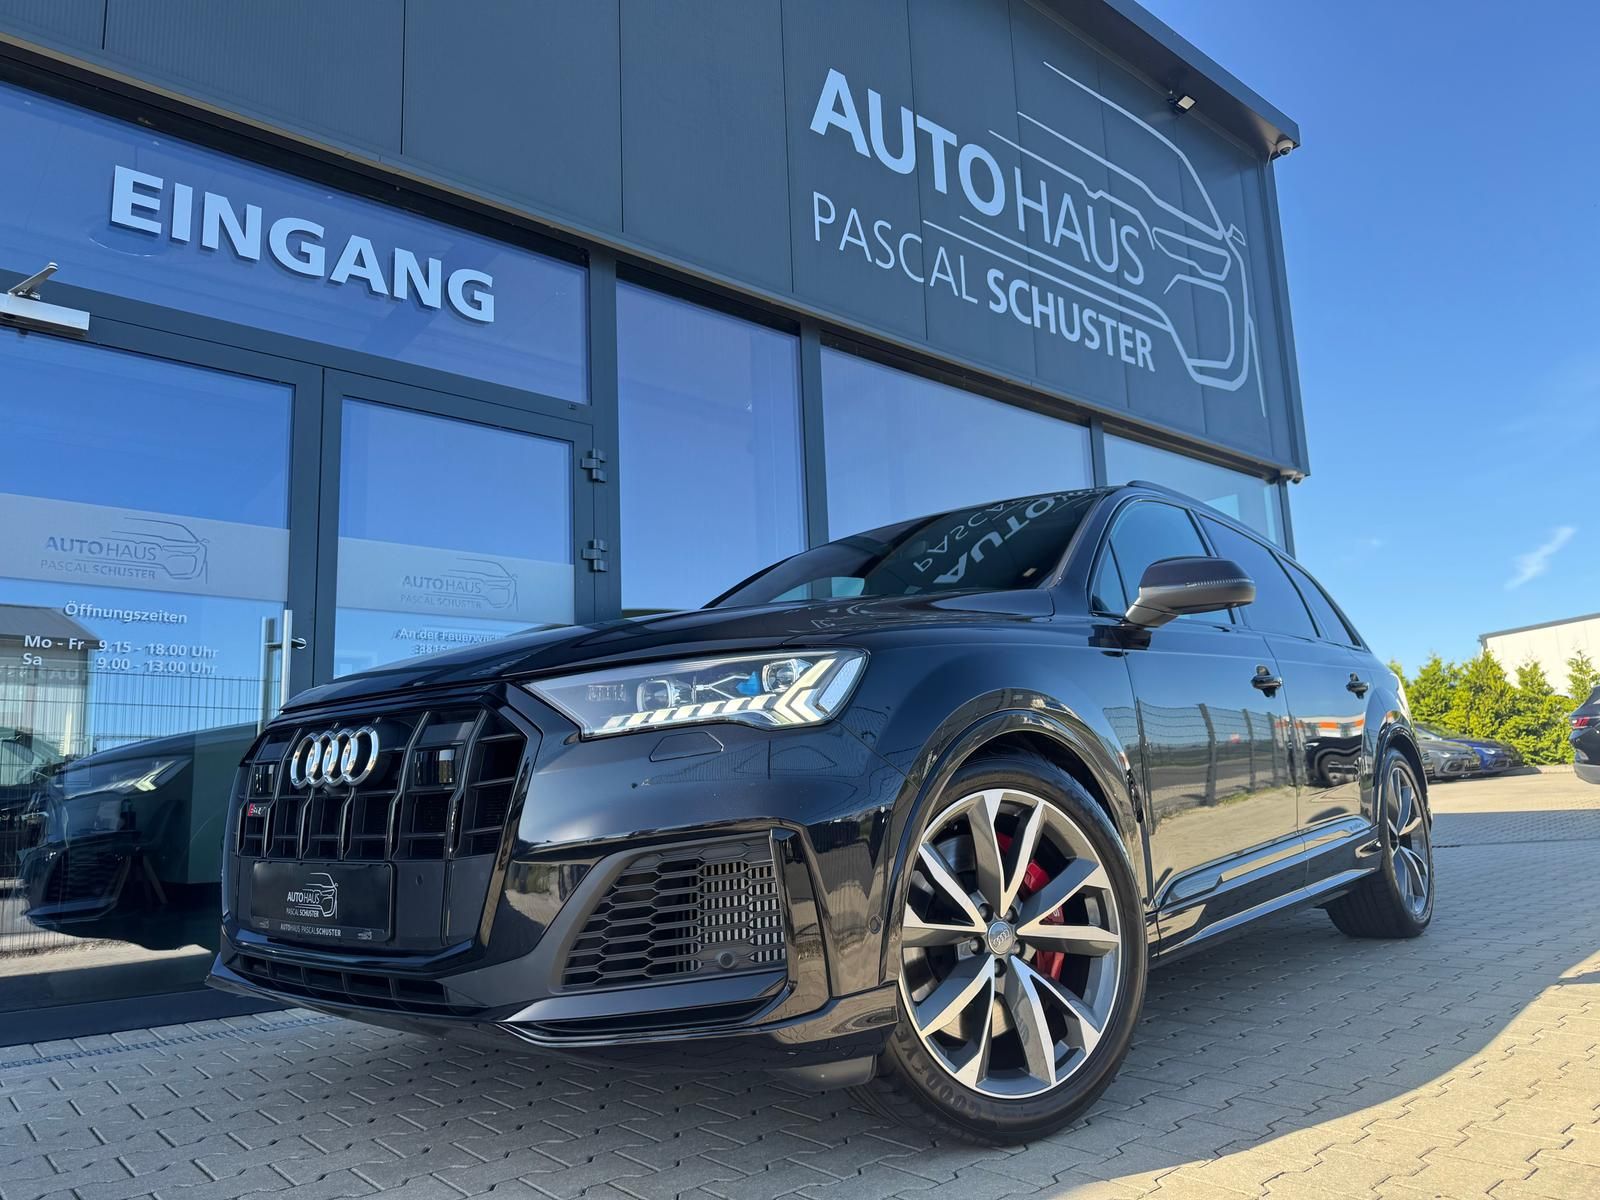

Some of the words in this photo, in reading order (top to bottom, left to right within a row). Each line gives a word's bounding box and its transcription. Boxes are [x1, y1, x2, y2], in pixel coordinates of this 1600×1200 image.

[809, 67, 1144, 286] AUTOHAUS
[111, 164, 496, 324] EINGANG
[812, 191, 978, 304] PASCAL
[985, 267, 1155, 372] SCHUSTER
[46, 536, 157, 561] AUTOHAUS
[41, 559, 89, 574] PASCAL
[92, 564, 156, 580] SCHUSTER
[402, 574, 482, 595] AUTOHAUS
[400, 593, 435, 606] PASCAL
[437, 597, 482, 609] SCHUSTER
[64, 600, 188, 625] Öffnungszeiten
[419, 628, 438, 640] der
[24, 635, 52, 649] Mo
[69, 638, 85, 650] Fr
[99, 640, 132, 653] 9.15
[149, 643, 188, 656] 18.00
[192, 646, 219, 658] Uhr
[23, 653, 42, 666] Sa
[96, 657, 130, 671] 9.00
[148, 660, 186, 674] 13.00
[191, 662, 217, 675] Uhr
[286, 891, 320, 904] AUTOHAUS
[299, 908, 320, 918] SCHUSTER
